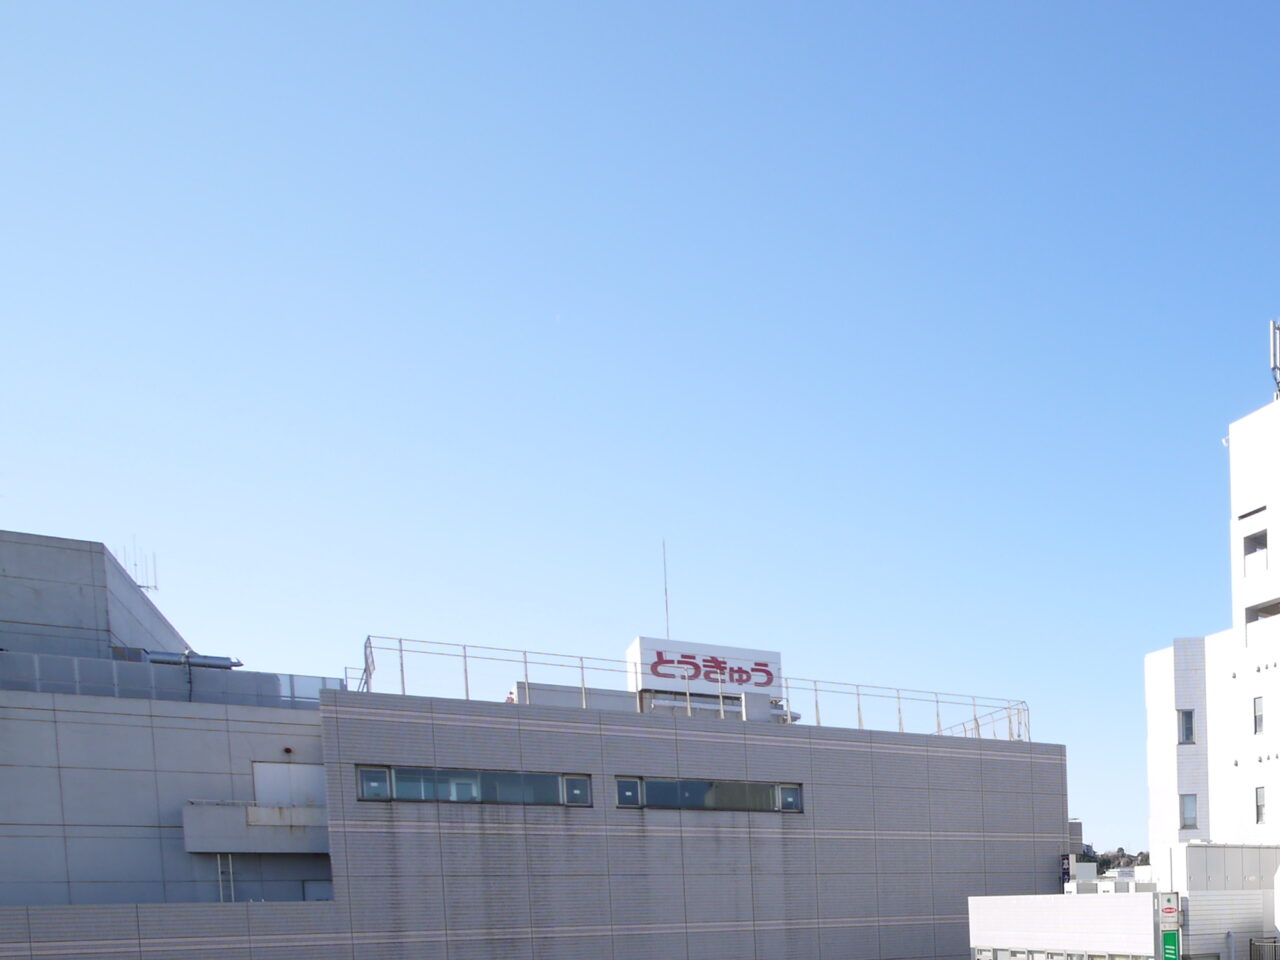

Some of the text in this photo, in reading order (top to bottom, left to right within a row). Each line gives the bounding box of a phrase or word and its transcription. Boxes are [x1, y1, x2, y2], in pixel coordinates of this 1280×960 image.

[650, 651, 774, 687] とうきゅう
